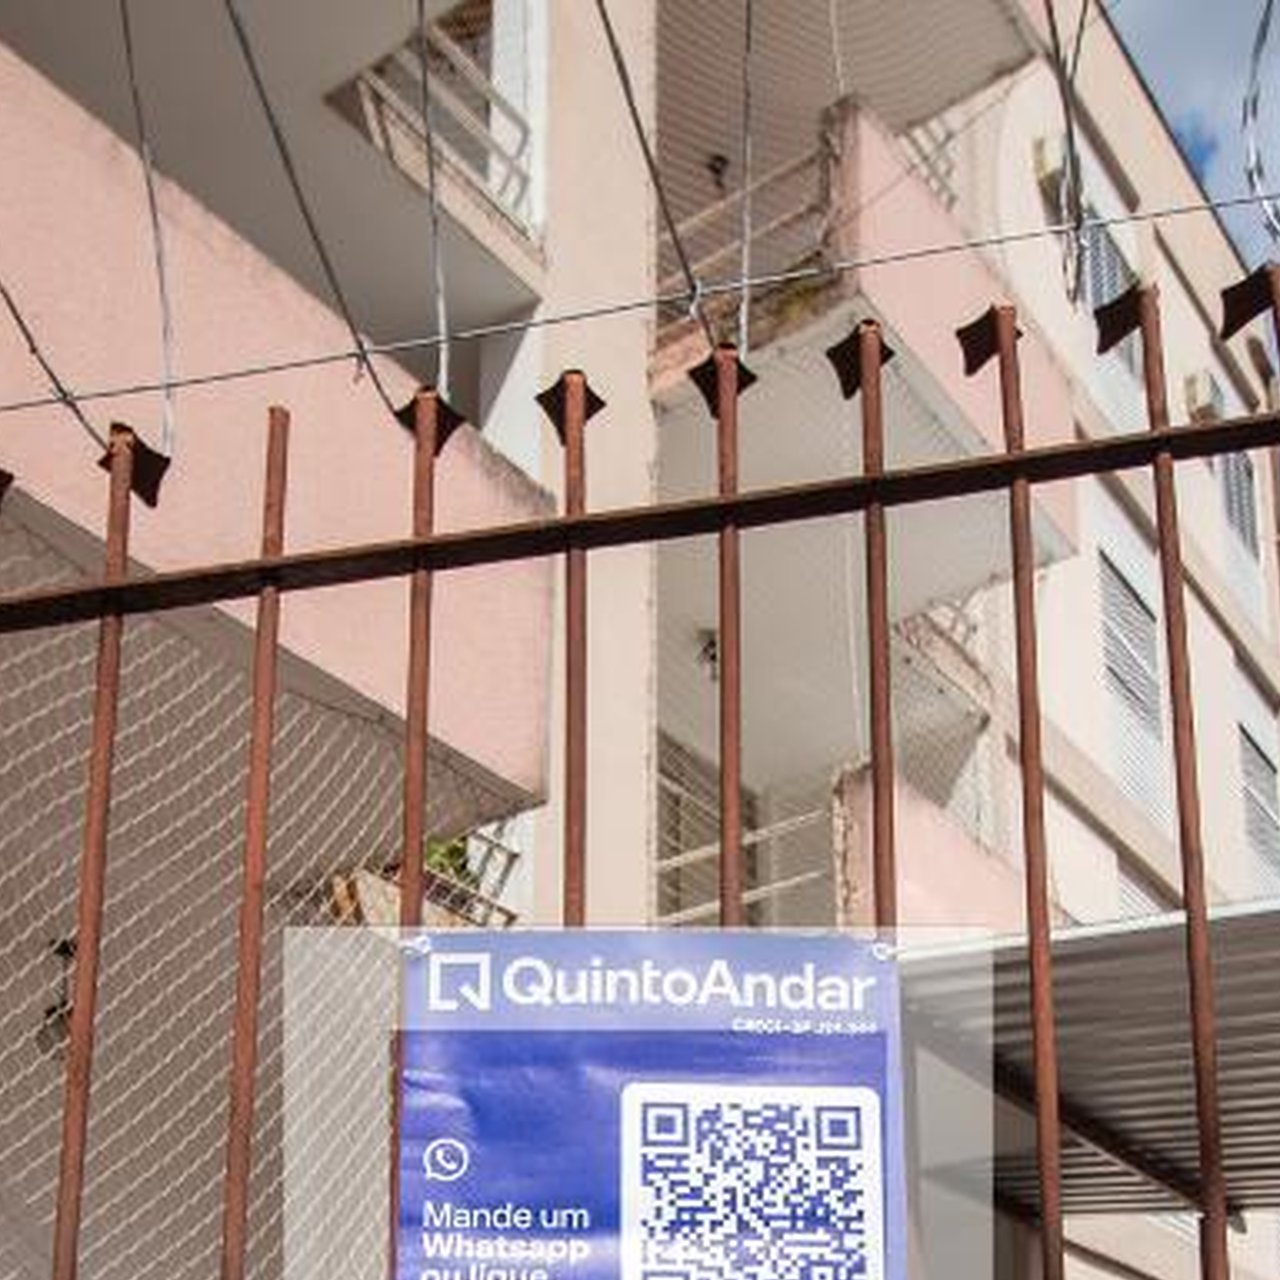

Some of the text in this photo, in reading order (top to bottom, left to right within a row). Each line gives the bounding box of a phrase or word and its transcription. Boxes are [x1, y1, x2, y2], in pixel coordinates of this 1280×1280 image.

[502, 956, 877, 1012] QuintoAndar
[422, 1201, 591, 1229] Mande um
[422, 1231, 592, 1265] Whatsapp
